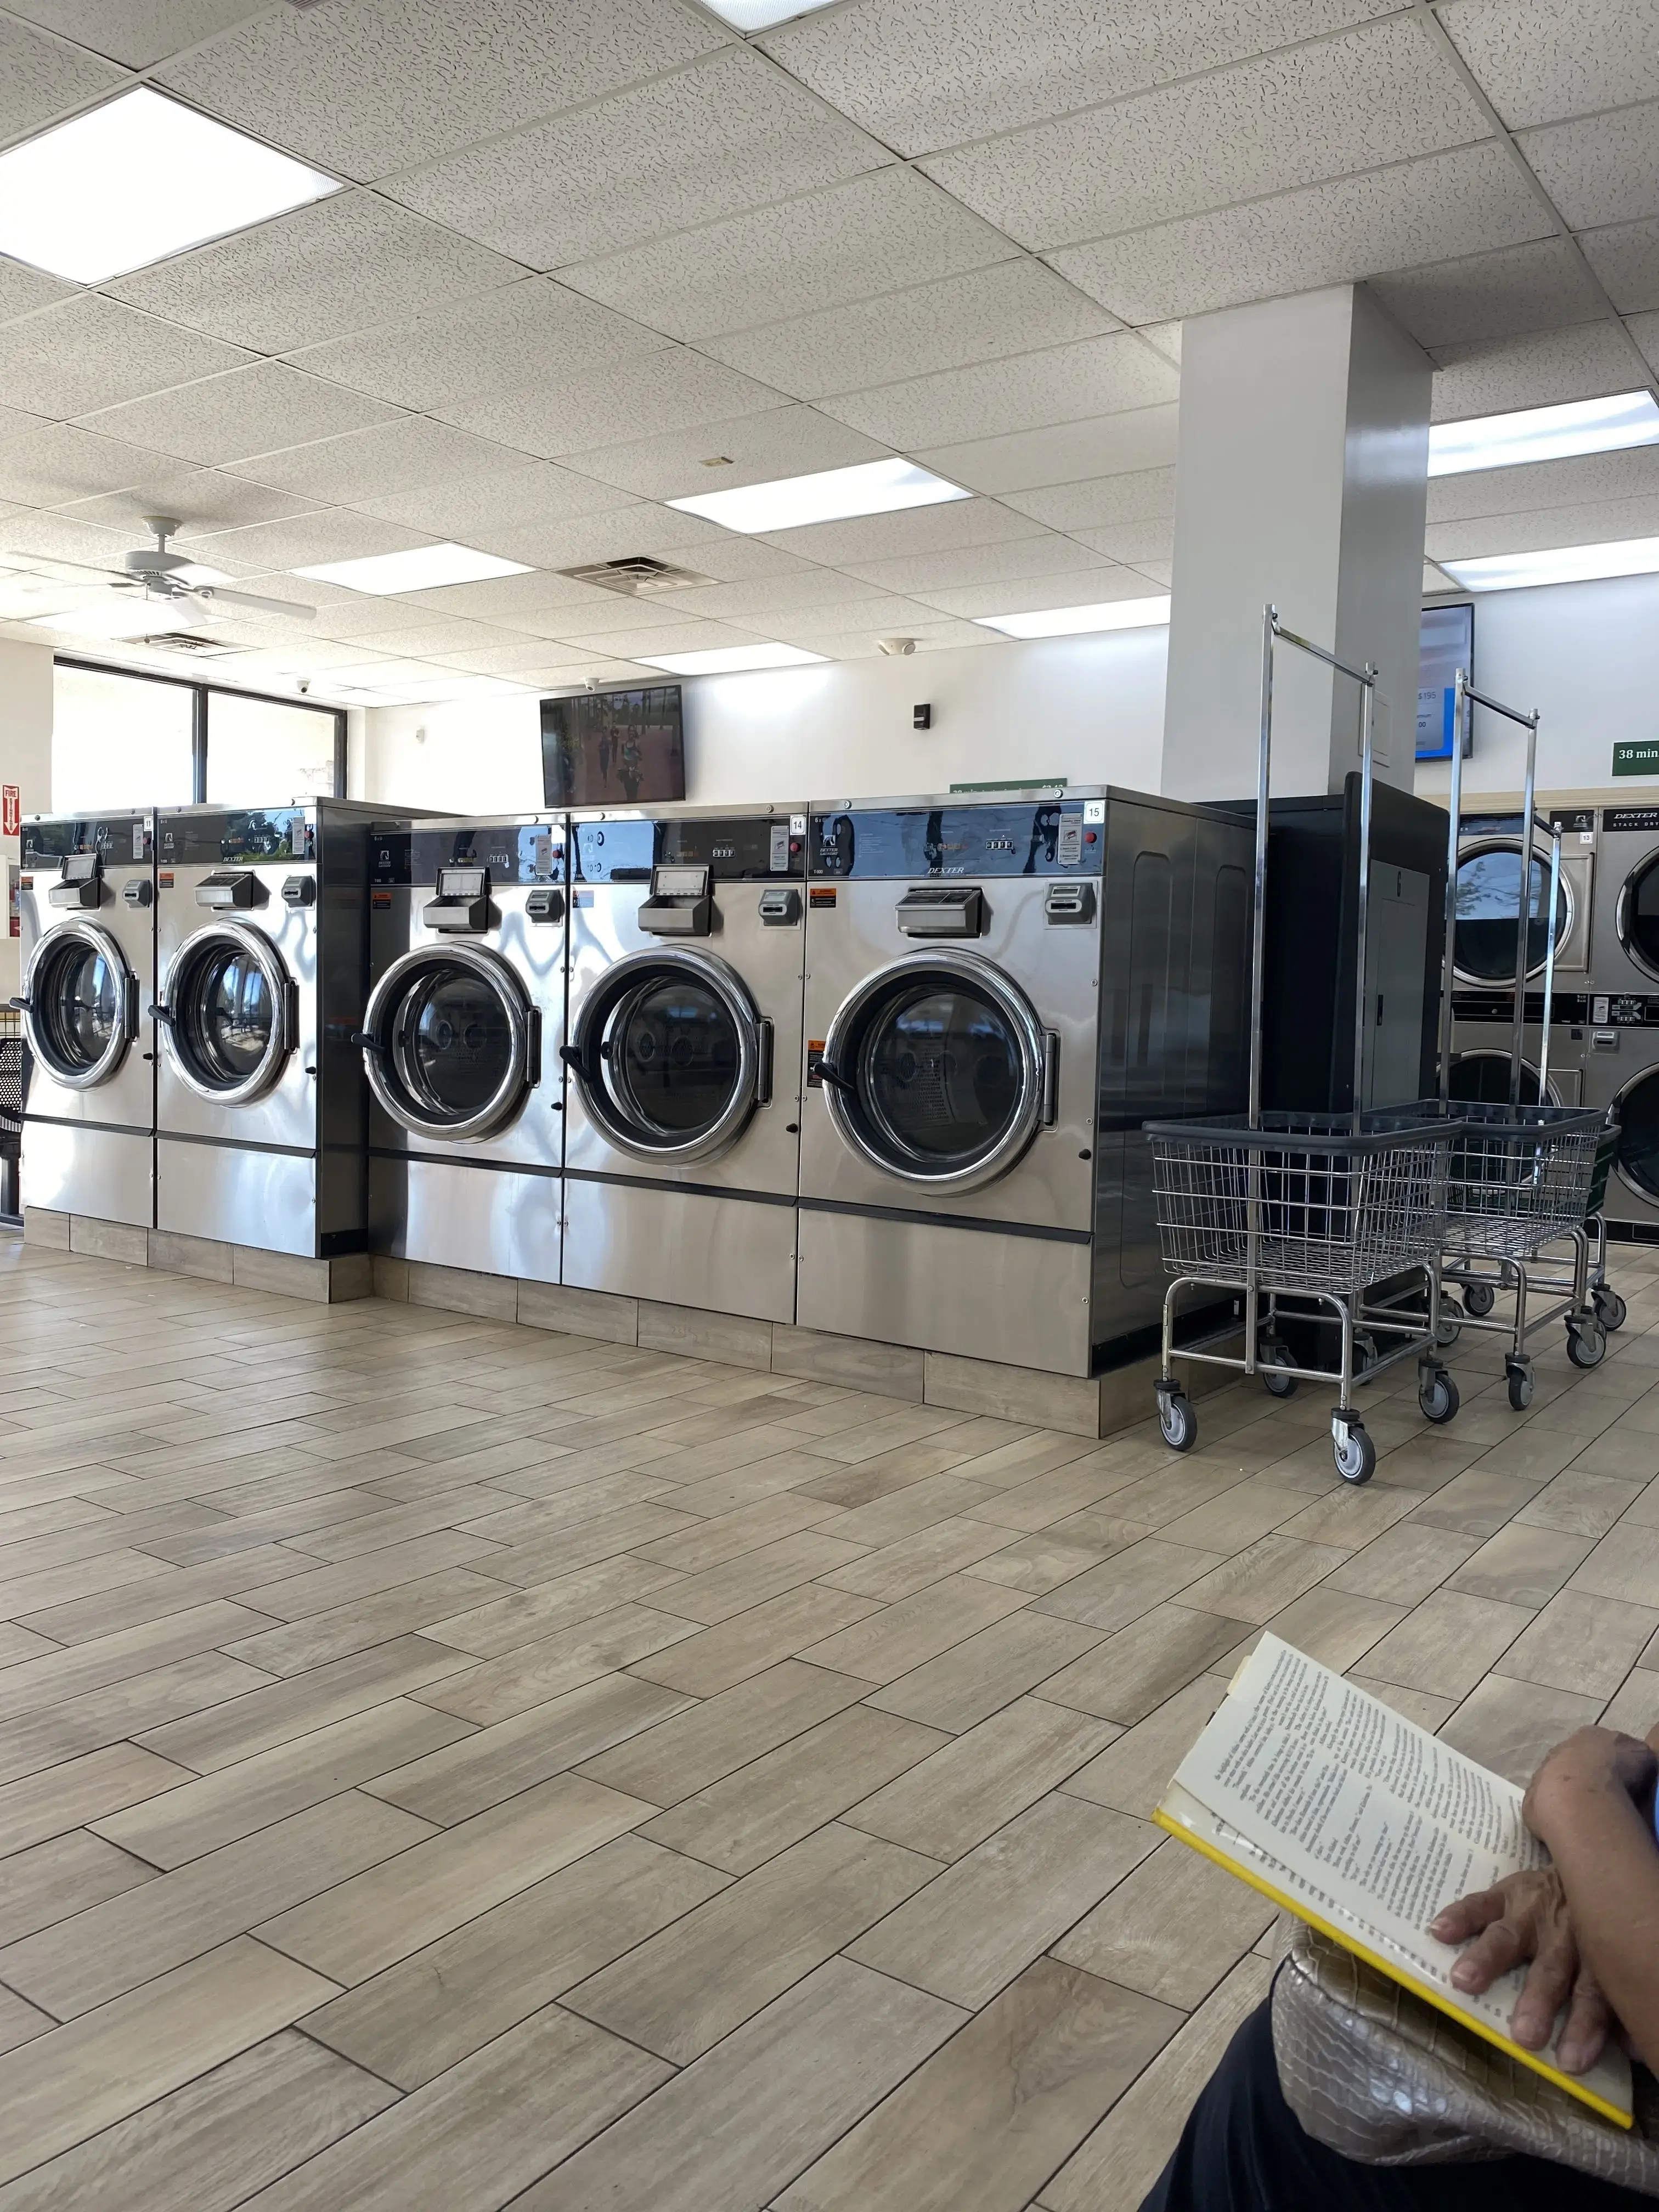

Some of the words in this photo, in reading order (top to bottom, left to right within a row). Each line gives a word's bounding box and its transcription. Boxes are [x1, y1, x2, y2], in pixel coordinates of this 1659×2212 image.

[1619, 749, 1633, 759] 38
[1089, 808, 1099, 817] 15
[794, 821, 802, 829] 14
